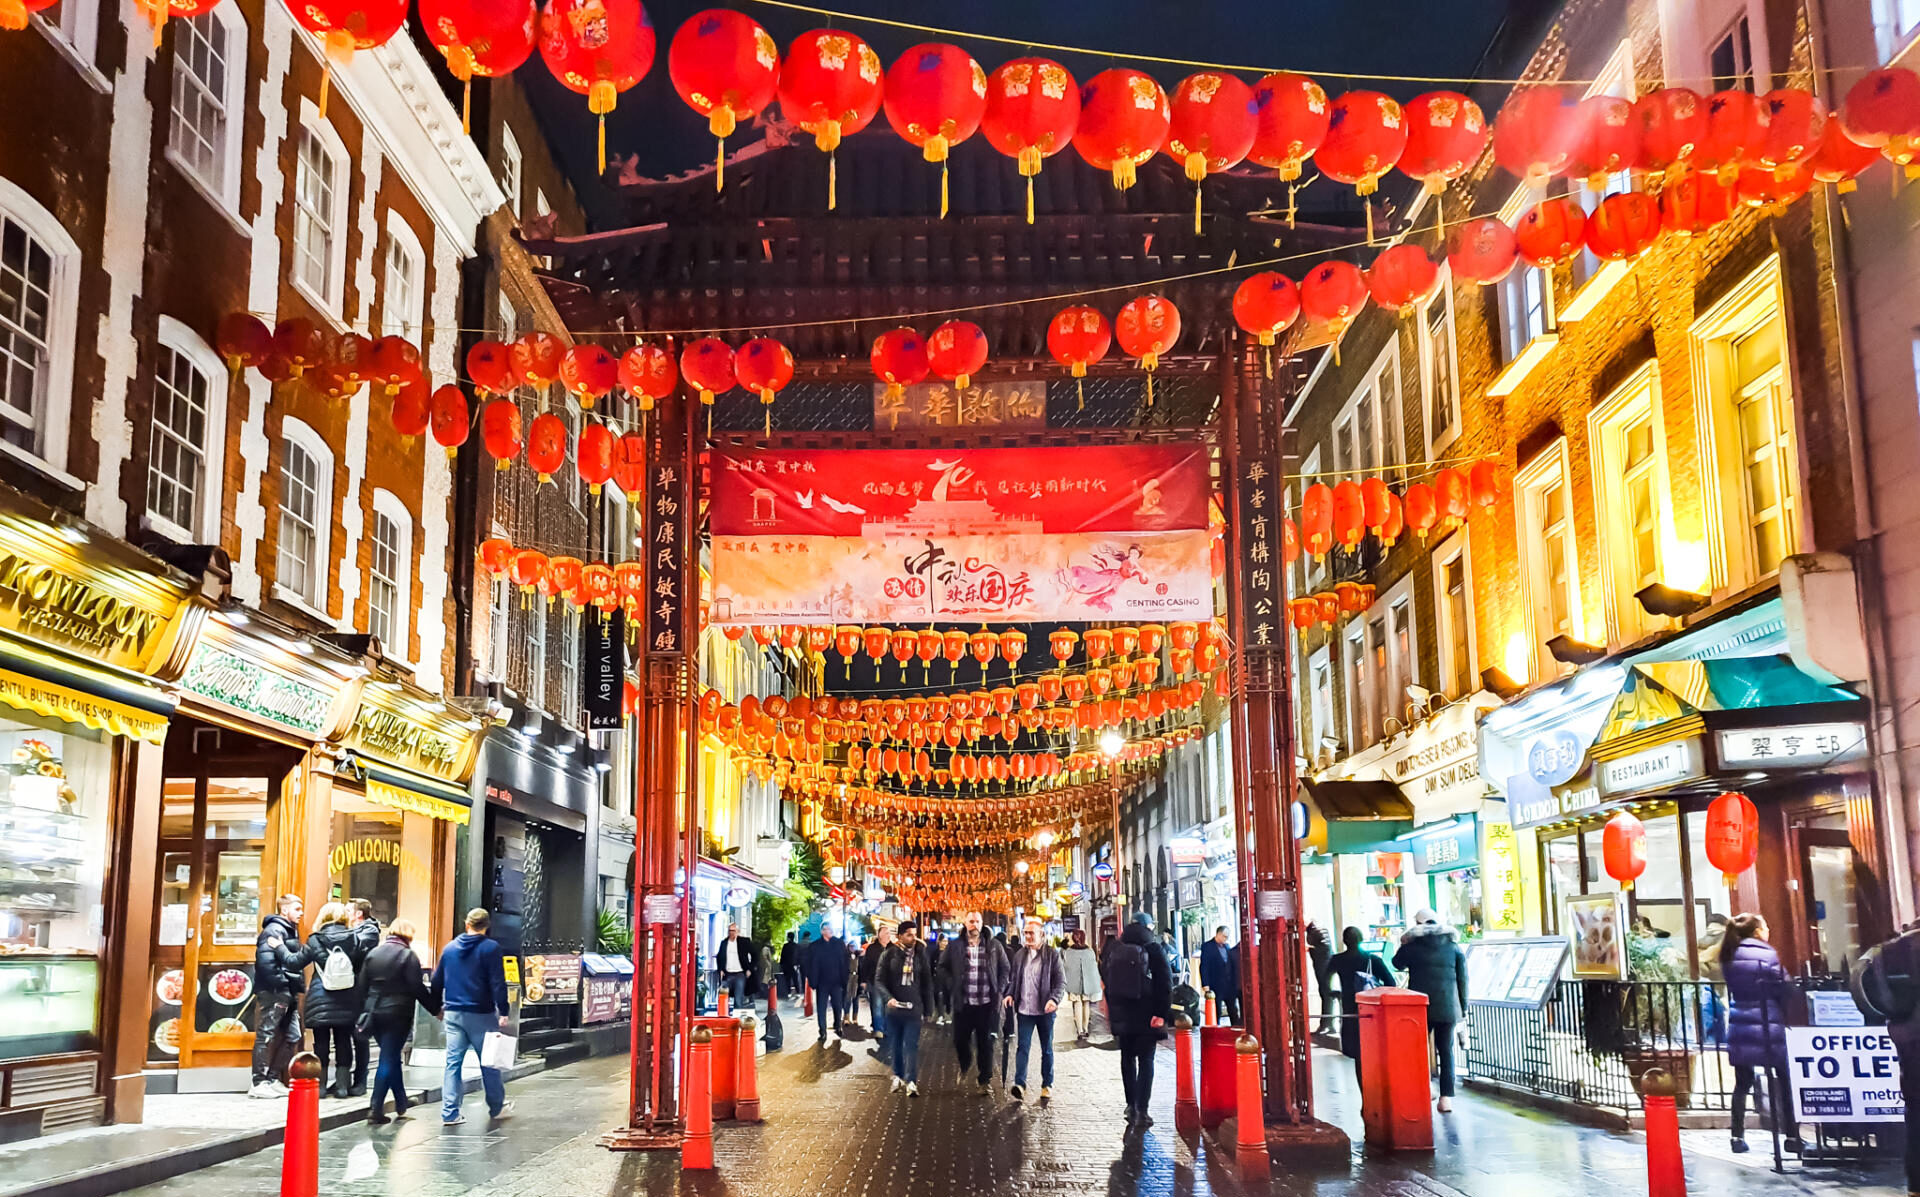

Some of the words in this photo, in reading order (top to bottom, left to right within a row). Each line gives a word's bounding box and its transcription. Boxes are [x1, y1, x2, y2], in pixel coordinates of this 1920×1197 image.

[4, 555, 159, 637] KOWLOON
[1126, 599, 1165, 608] GENTING
[1166, 598, 1199, 606] CASINO
[20, 604, 121, 647] RESTAURANT
[599, 655, 615, 702] valley
[30, 687, 61, 711] BUFFET
[71, 699, 90, 718] CAKE
[1439, 767, 1456, 789] SUM
[1612, 755, 1671, 784] RESTAURANT
[328, 837, 391, 874] KOWLOON
[1812, 1035, 1892, 1051] OFFICE
[1794, 1056, 1840, 1079] TO
